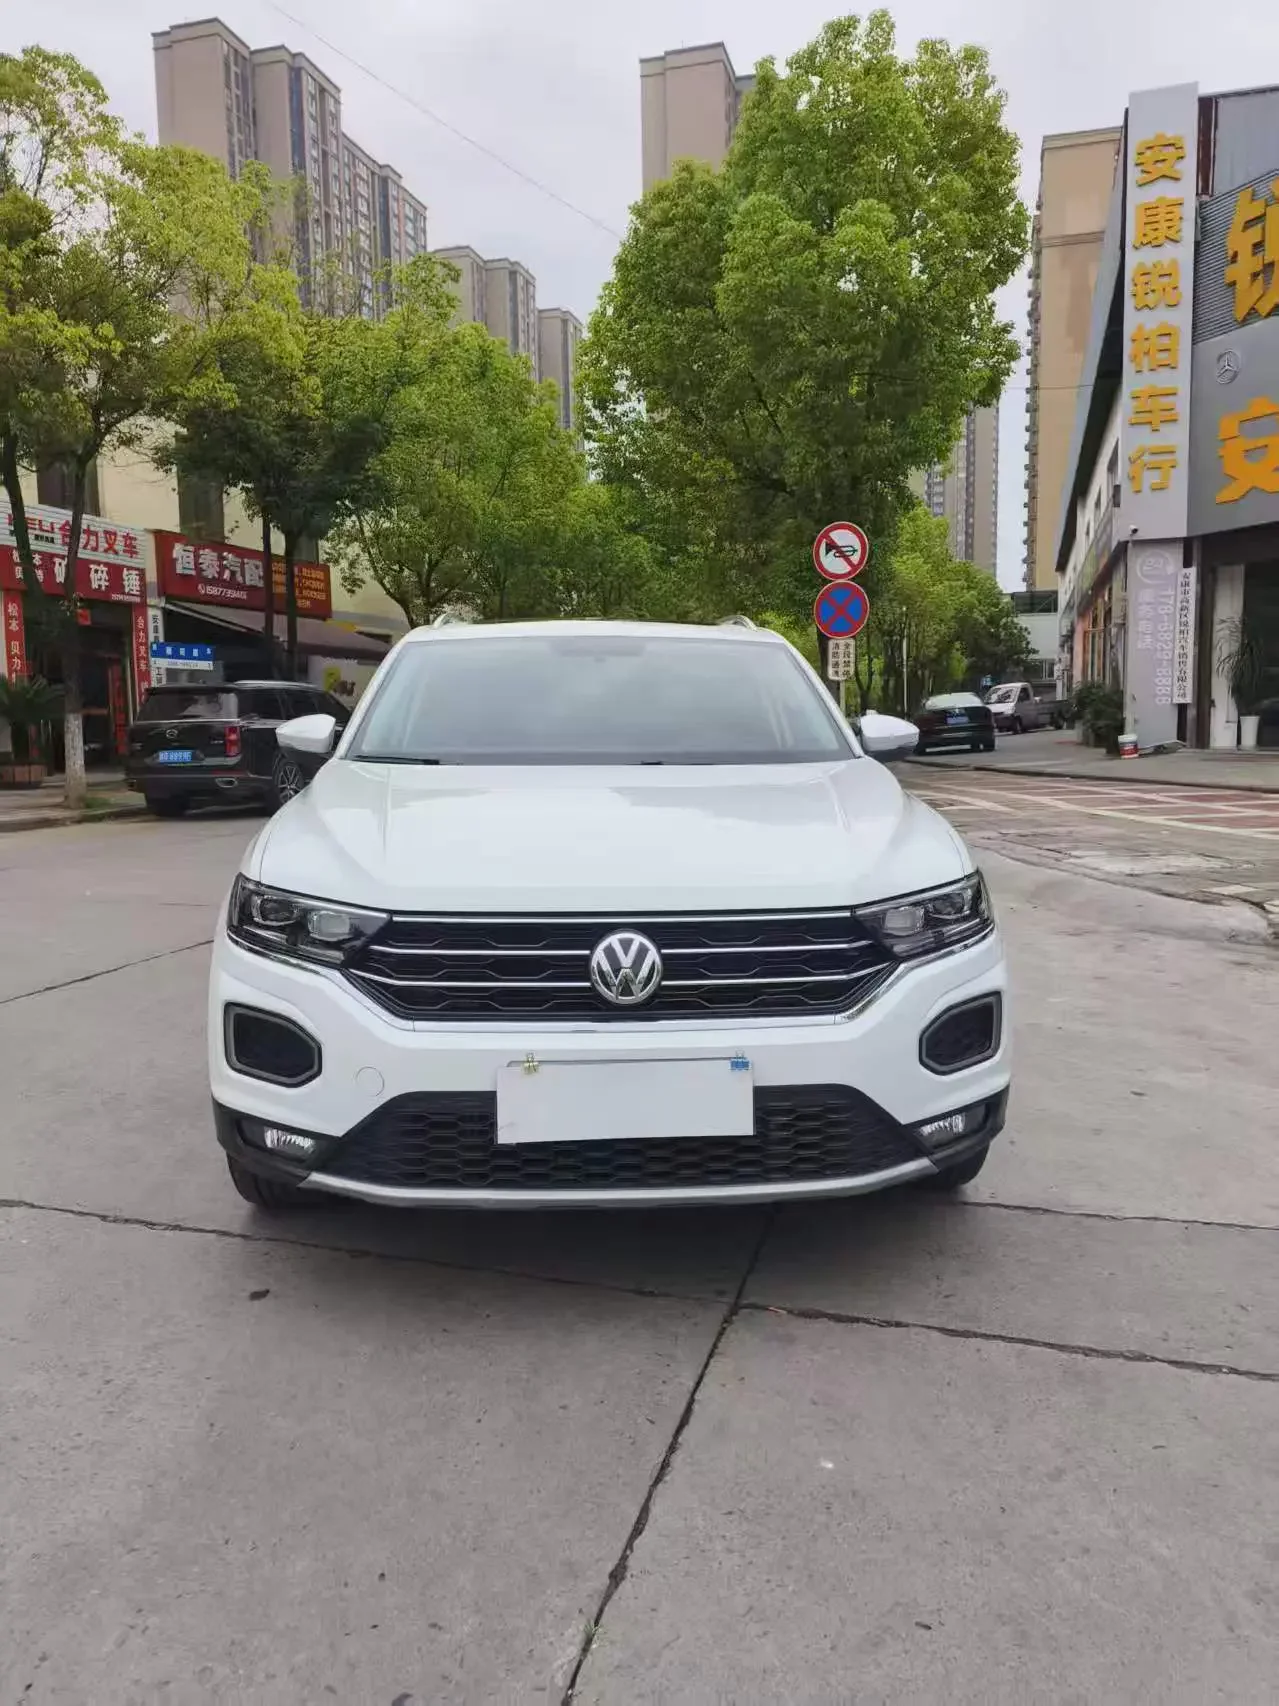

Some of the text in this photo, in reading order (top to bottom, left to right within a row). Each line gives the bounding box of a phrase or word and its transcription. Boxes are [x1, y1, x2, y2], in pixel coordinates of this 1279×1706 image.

[1128, 132, 1187, 494] 安康锐柏车行
[172, 542, 265, 588] 恒泰汽配
